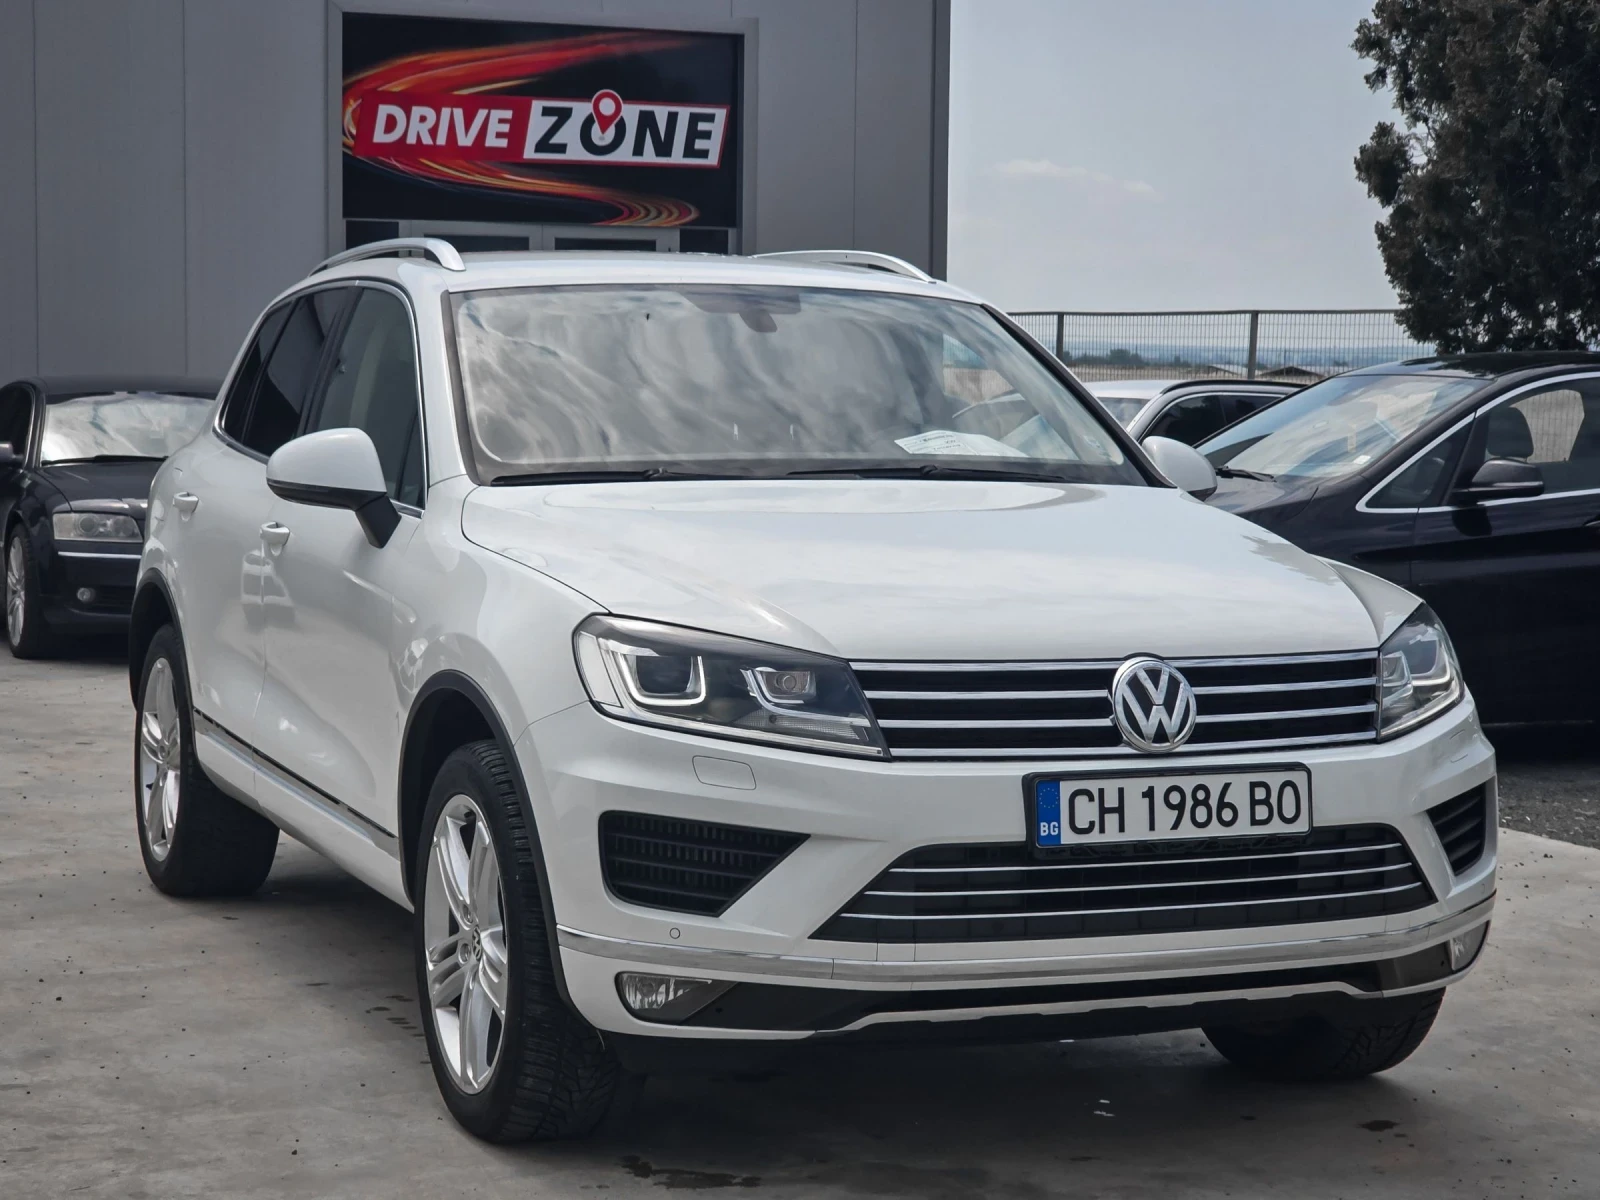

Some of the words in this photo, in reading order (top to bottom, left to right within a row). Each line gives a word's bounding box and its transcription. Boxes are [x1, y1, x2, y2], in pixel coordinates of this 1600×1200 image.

[372, 104, 513, 148] DRIVE
[534, 105, 716, 159] ZONE
[1040, 822, 1059, 836] BG
[1068, 787, 1125, 835] CH
[1141, 782, 1239, 831] 1986
